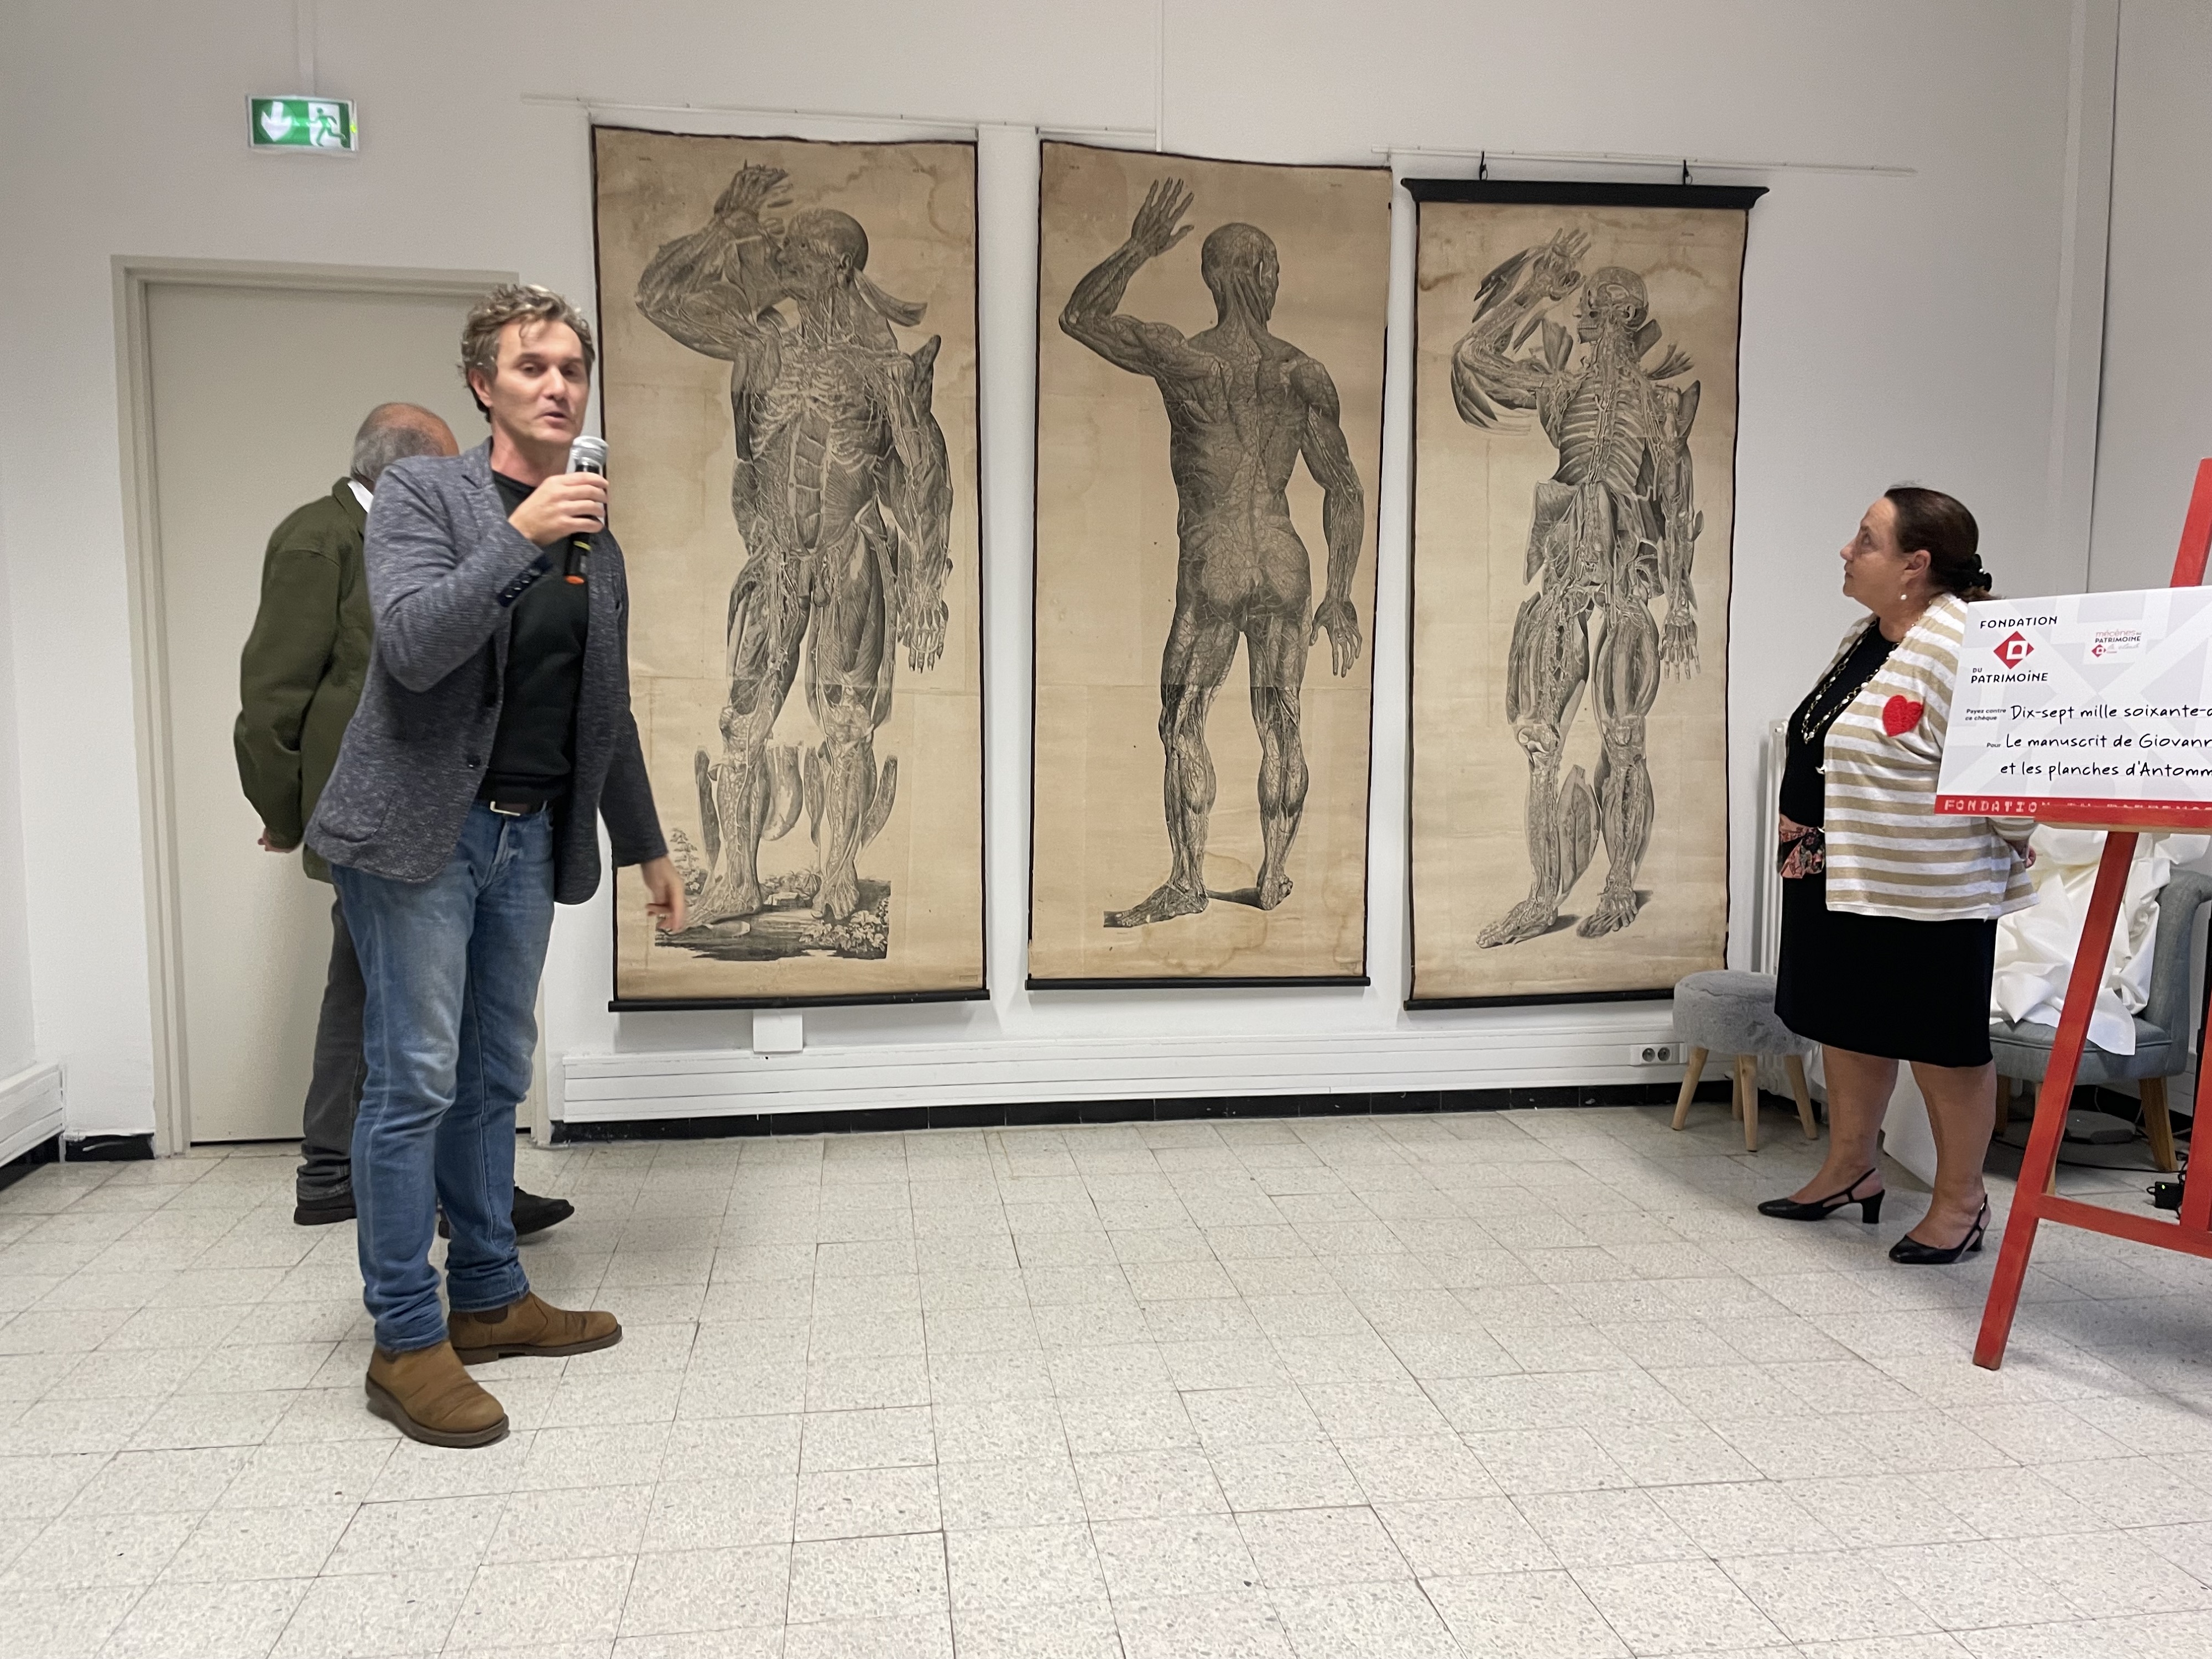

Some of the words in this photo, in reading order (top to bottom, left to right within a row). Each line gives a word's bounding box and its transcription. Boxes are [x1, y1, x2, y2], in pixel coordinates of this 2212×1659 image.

[1980, 616, 2058, 629] FONDATION
[2010, 705, 2075, 724] Dix-sept
[2080, 704, 2117, 718] mille
[2006, 733, 2022, 748] Le
[2028, 734, 2107, 748] manuscrit
[2113, 734, 2132, 747] de
[2000, 763, 2016, 775] et
[2022, 761, 2042, 775] les
[2048, 761, 2119, 781] planches
[1944, 800, 2051, 813] FONDATIO
